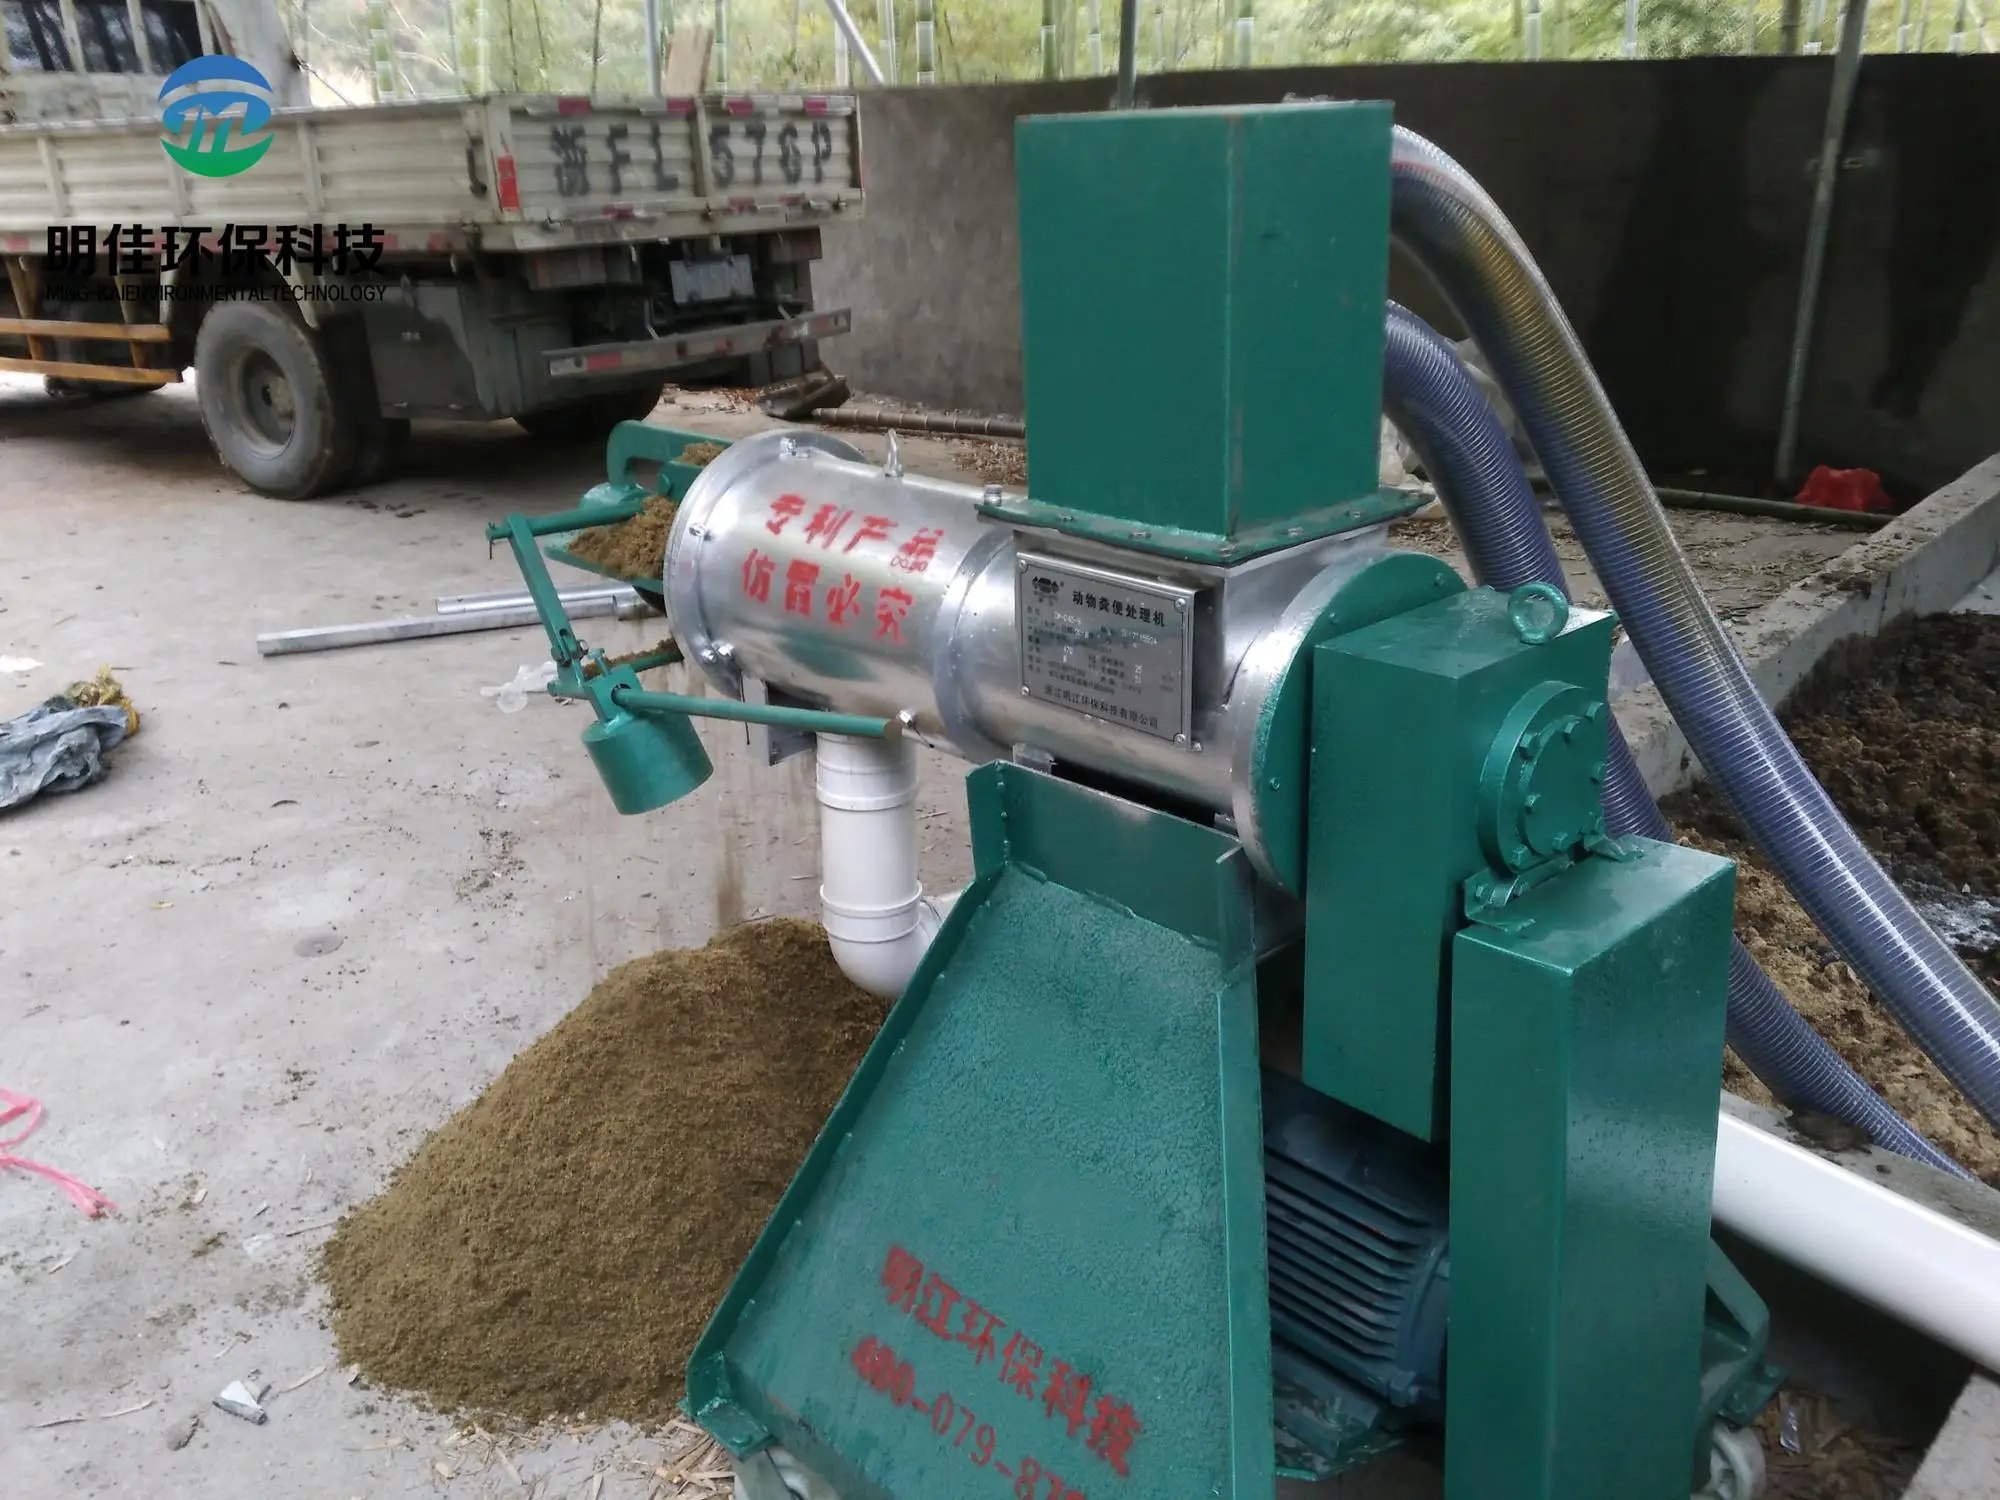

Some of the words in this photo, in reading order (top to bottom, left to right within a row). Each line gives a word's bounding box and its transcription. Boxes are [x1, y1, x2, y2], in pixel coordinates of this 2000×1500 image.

[742, 548, 913, 646] 仿冒必究
[1071, 590, 1166, 627] 动物粪便处理机
